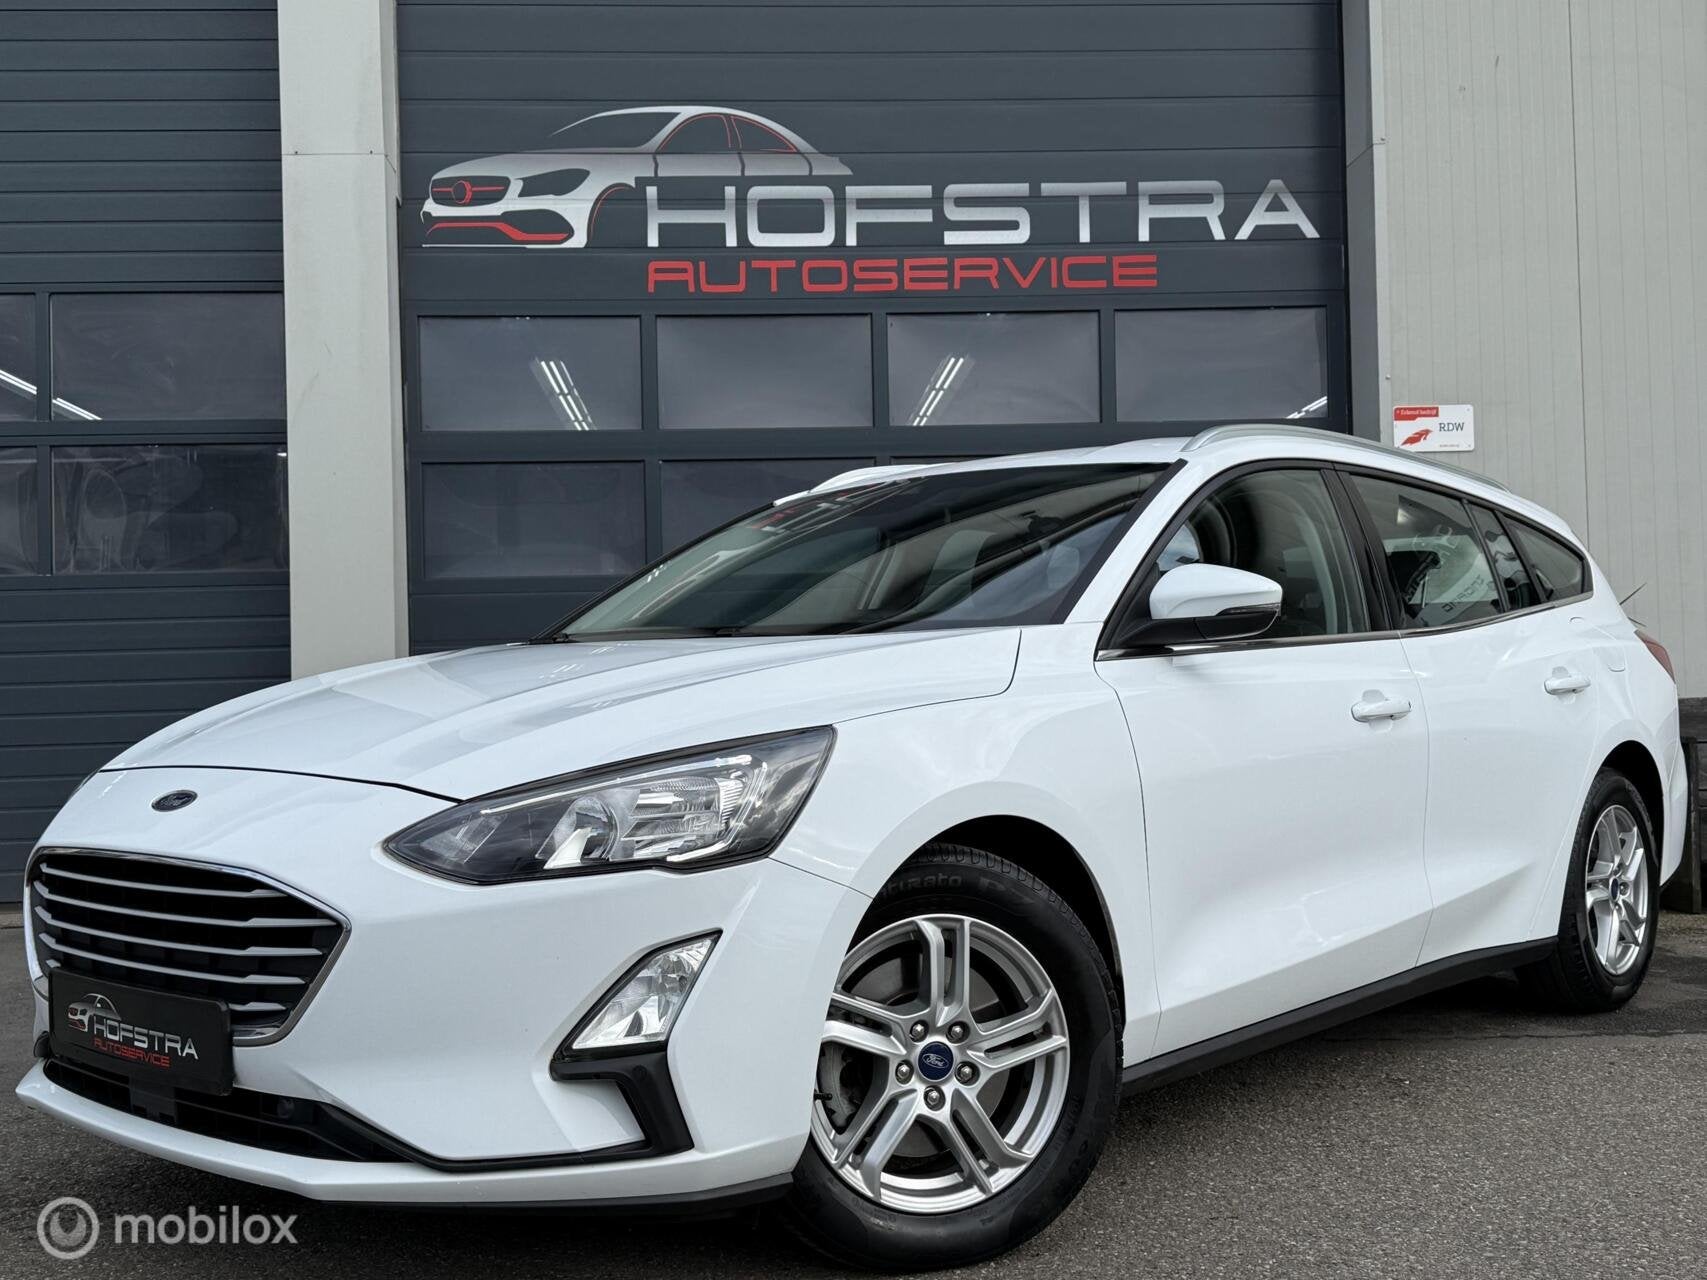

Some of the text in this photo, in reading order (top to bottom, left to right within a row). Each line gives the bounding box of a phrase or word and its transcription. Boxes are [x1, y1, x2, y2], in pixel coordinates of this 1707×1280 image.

[646, 178, 1320, 248] HOFSTRA
[647, 254, 1158, 294] AUTOSERVICE
[1438, 422, 1465, 432] RDW
[94, 1015, 199, 1060] HOFSTRA
[94, 1038, 170, 1068] AUTOSERVICE
